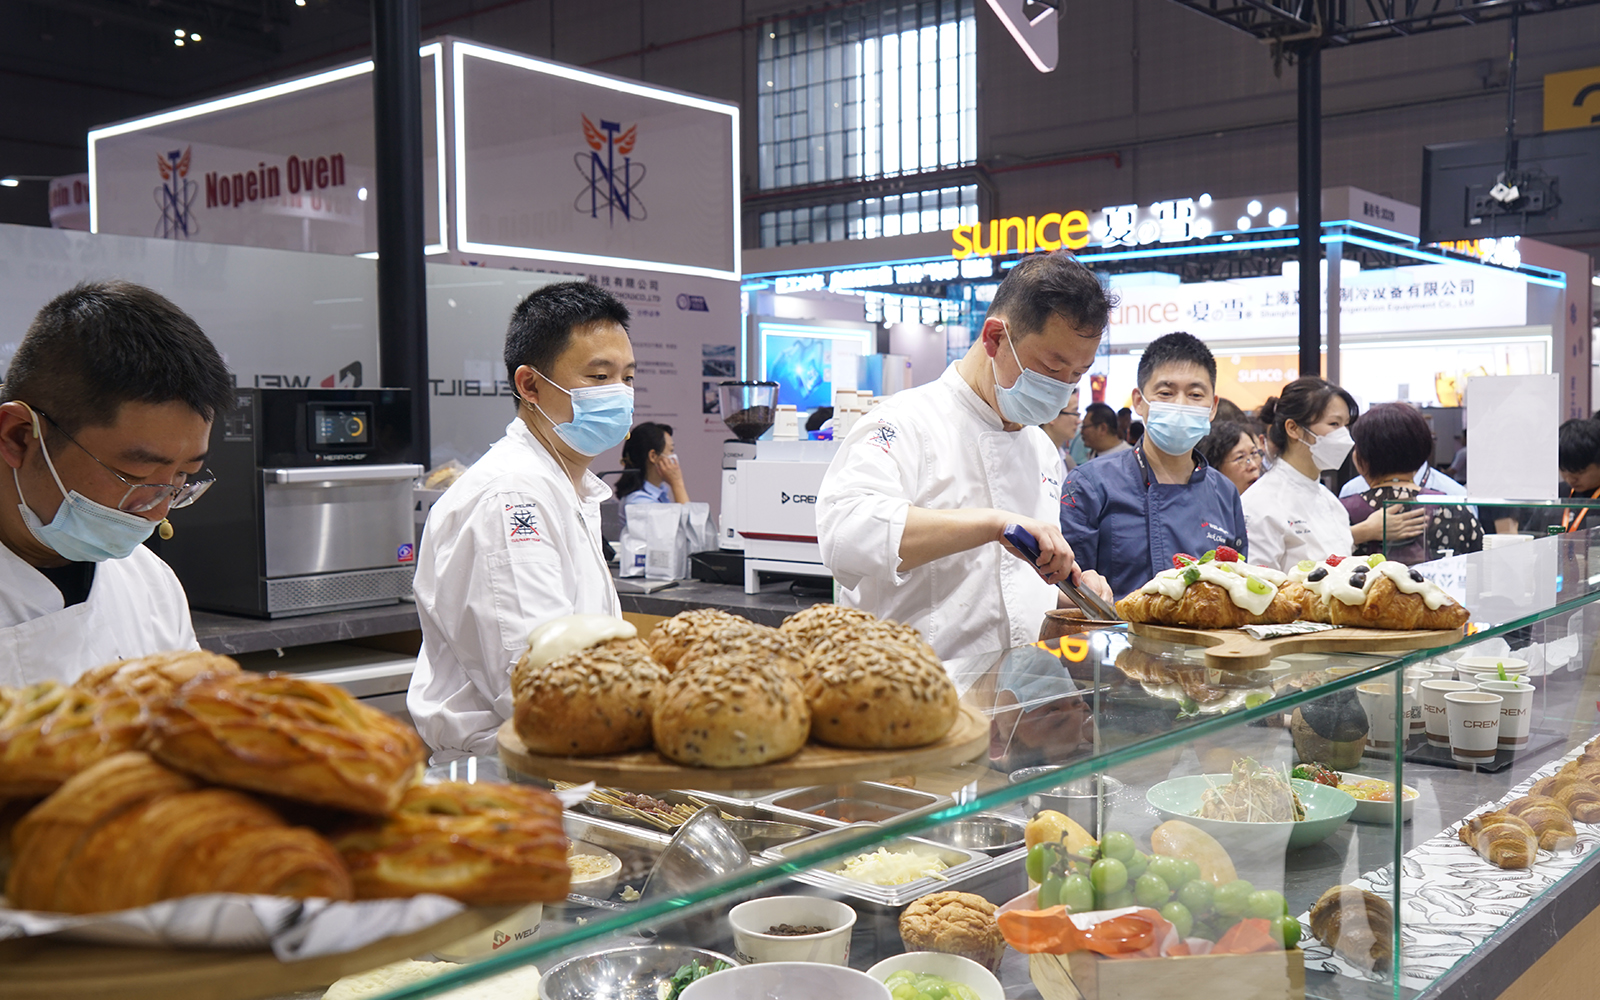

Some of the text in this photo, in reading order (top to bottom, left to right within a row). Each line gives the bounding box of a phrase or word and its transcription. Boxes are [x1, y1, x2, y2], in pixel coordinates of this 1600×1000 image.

[205, 162, 280, 210] Nopein
[286, 152, 345, 195] Oven
[951, 209, 1091, 260] sunice
[1262, 279, 1474, 306] 上海制冷设备有限公司
[1108, 302, 1179, 325] unice
[792, 494, 818, 504] CRE
[1424, 703, 1447, 715] REM
[1500, 708, 1527, 717] REM
[1463, 719, 1499, 729] CREM
[514, 922, 541, 941] WELB
